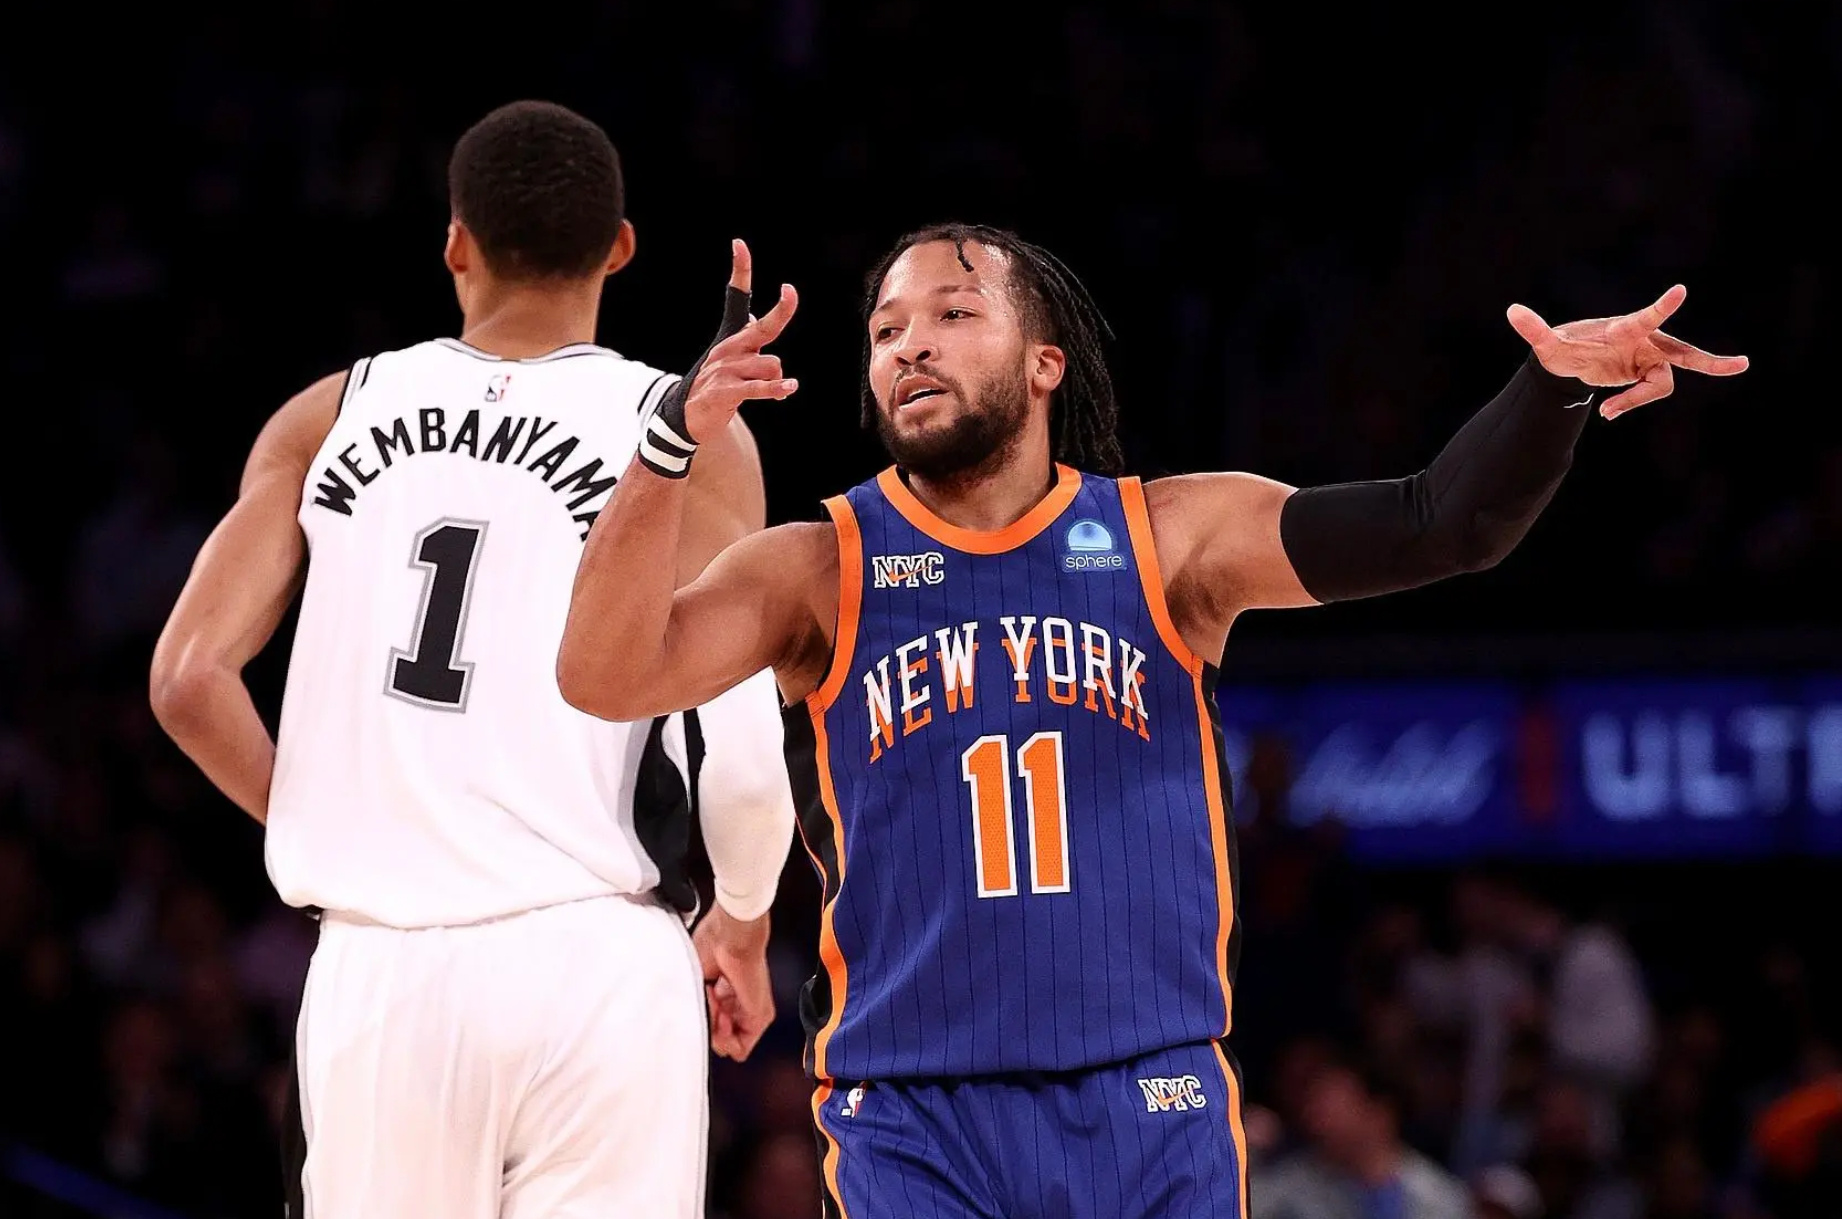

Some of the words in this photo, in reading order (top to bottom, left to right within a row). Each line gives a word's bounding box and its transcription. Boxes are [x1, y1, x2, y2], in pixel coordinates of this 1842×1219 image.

[872, 552, 945, 588] NYC
[1065, 554, 1123, 571] sphere
[383, 516, 490, 714] 1
[863, 621, 979, 764] NEW
[999, 616, 1150, 742] YORK
[961, 731, 1071, 898] 11
[1138, 1075, 1207, 1112] NYC
